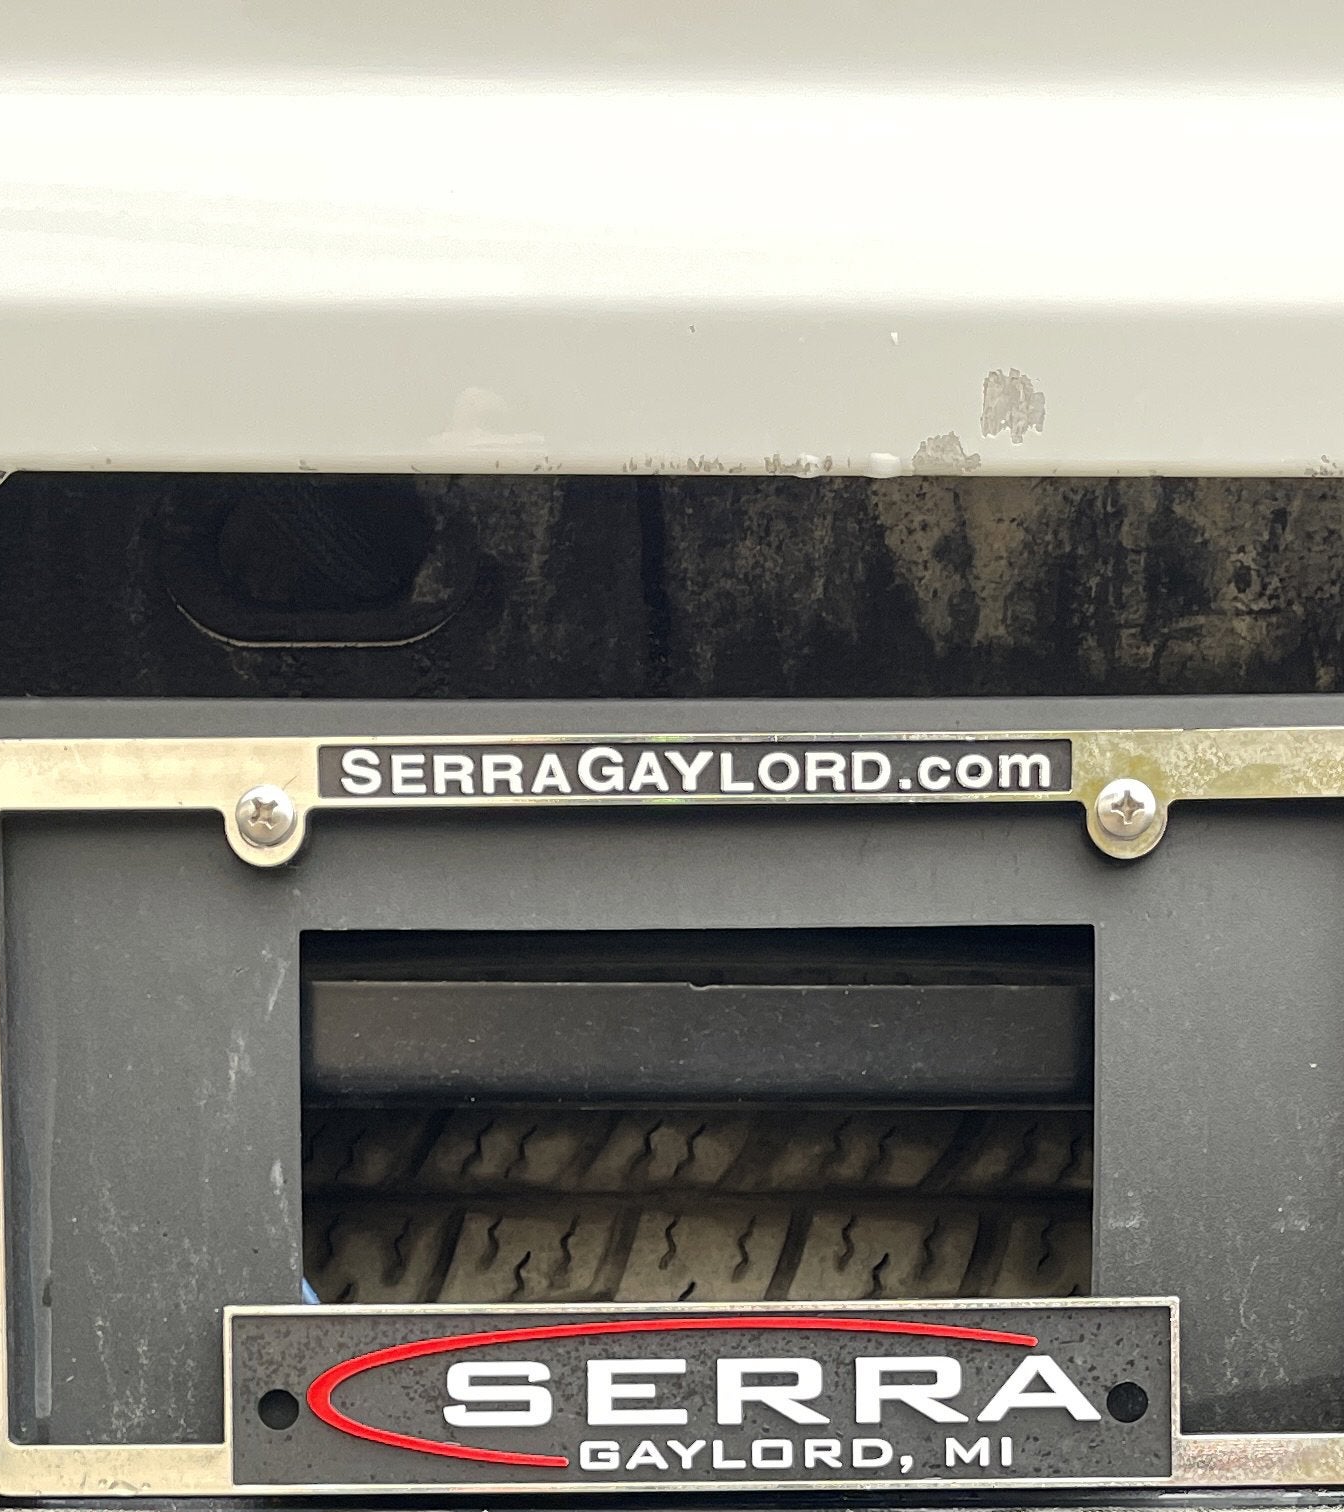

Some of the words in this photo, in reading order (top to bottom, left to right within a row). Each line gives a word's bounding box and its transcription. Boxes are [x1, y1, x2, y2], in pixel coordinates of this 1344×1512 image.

[338, 745, 1053, 796] SERRAGAYLORD.com
[442, 1354, 1103, 1428] SERRA
[579, 1437, 912, 1473] GAYLORD,
[946, 1436, 1015, 1468] MI
